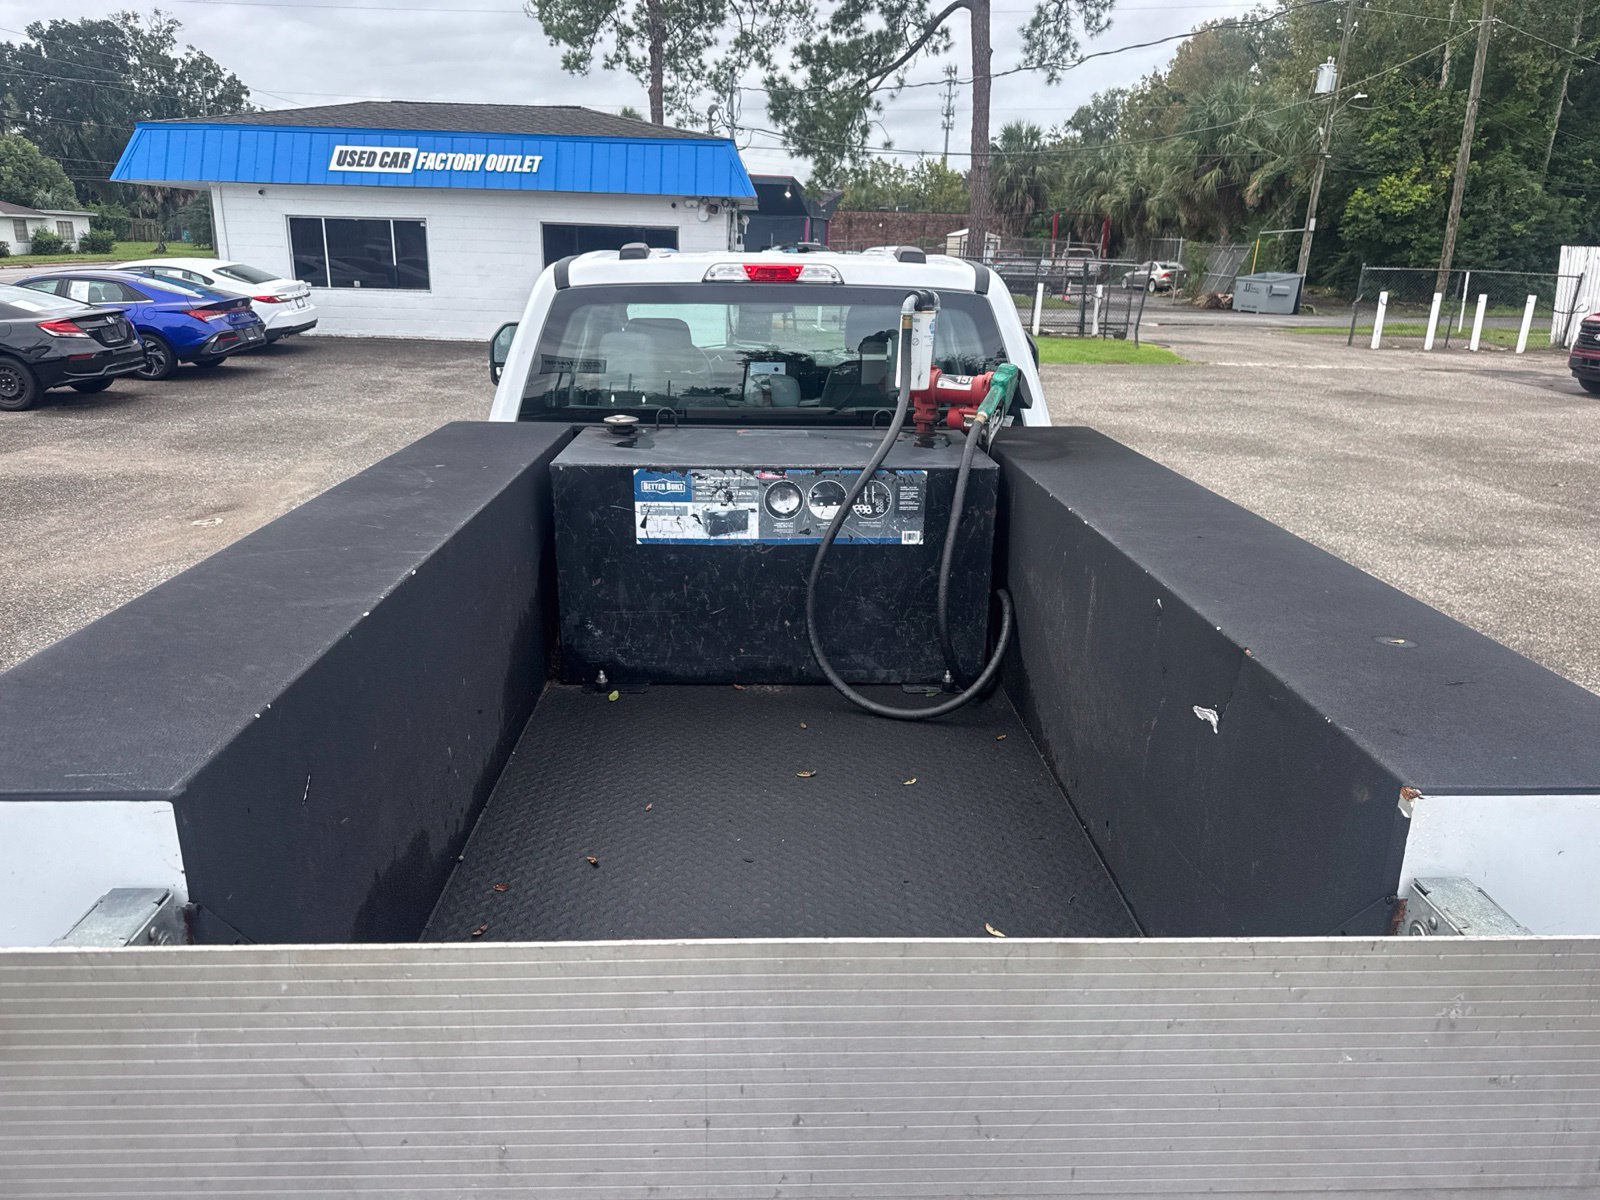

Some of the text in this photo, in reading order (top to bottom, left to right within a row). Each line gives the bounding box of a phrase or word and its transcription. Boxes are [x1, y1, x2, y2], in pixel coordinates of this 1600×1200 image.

[336, 149, 543, 173] USED CAR FACTORY OUTLET
[643, 482, 683, 491] BETTER BUILT
